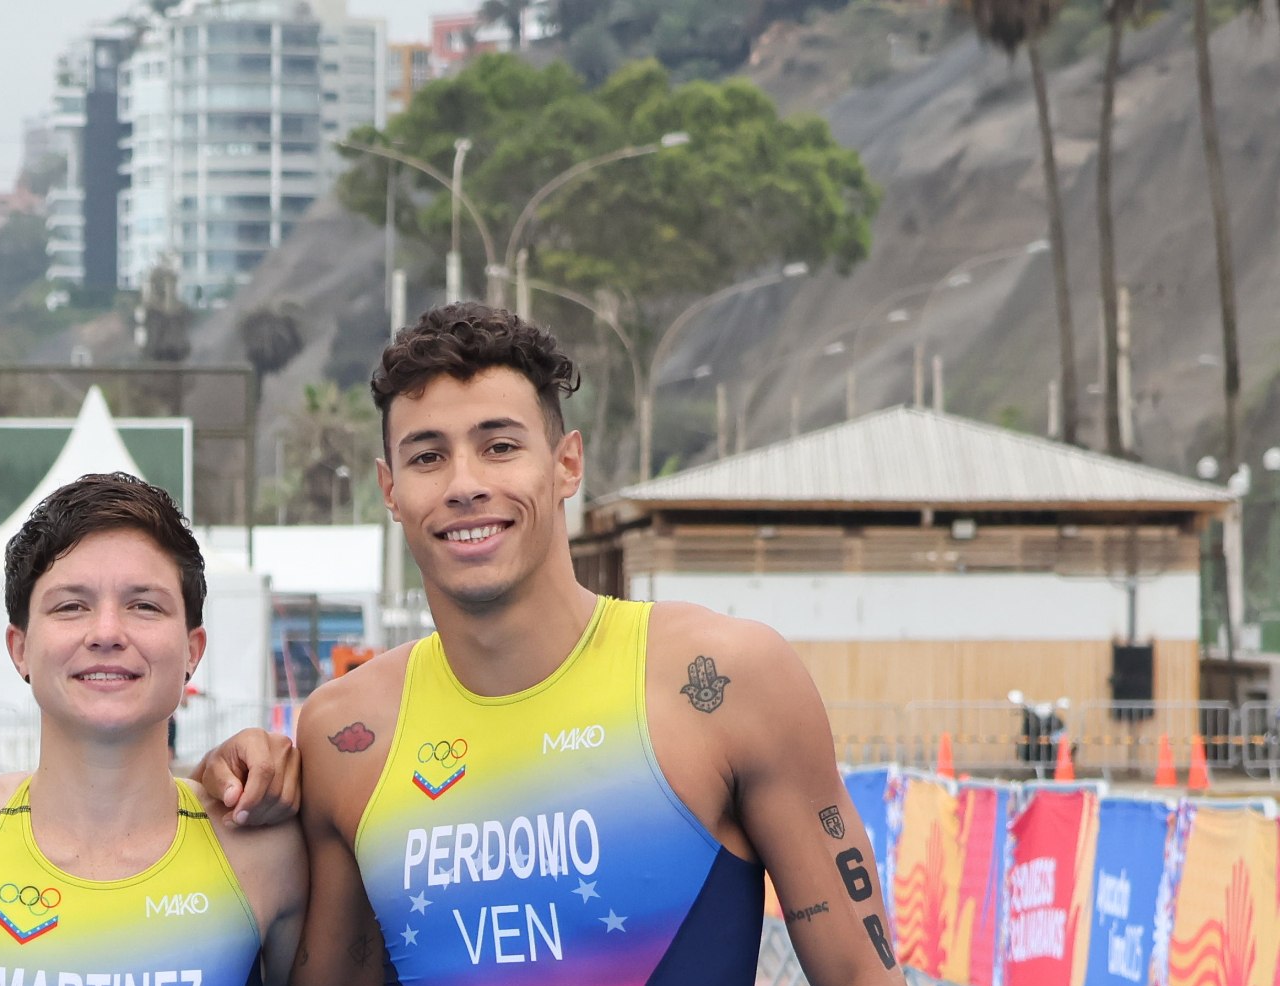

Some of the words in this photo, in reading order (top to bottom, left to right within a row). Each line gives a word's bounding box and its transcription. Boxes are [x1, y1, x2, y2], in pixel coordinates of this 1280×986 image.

[543, 725, 605, 754] MAKO
[404, 809, 600, 890] PERDOMO
[836, 847, 873, 902] 6
[146, 892, 209, 918] MAKO
[453, 902, 563, 965] VEN
